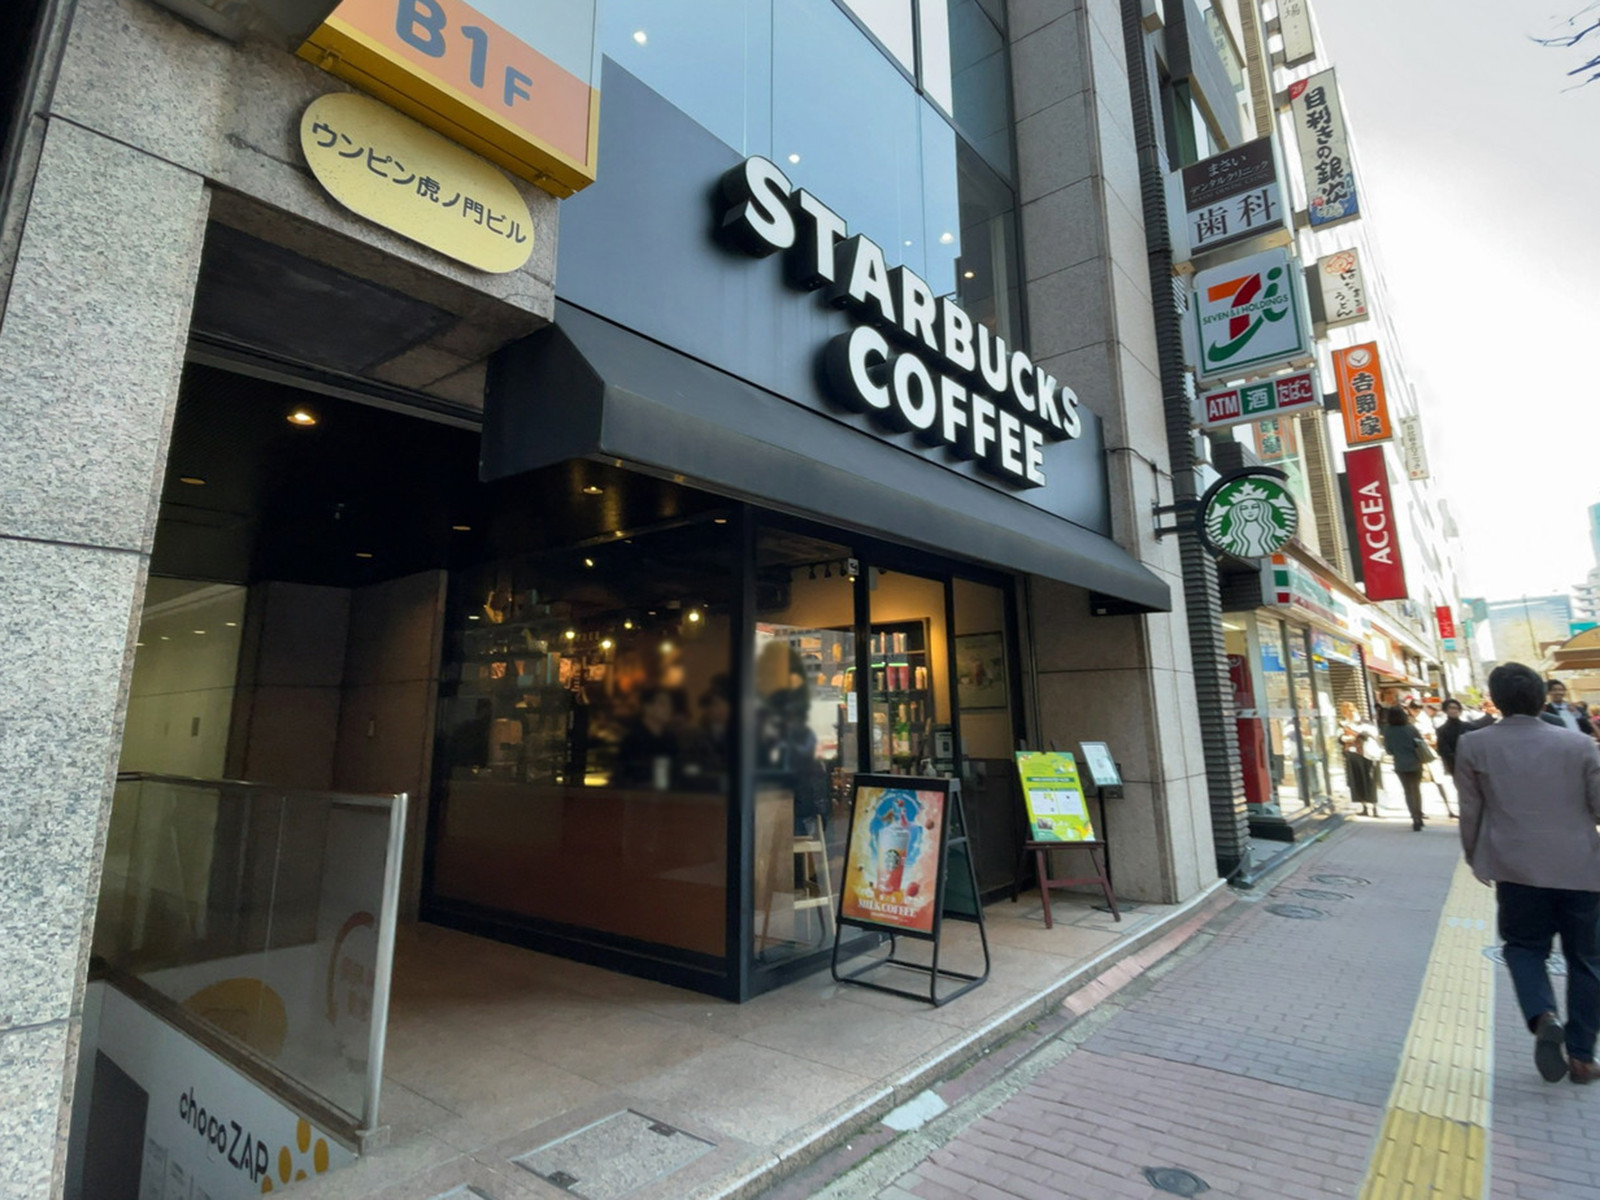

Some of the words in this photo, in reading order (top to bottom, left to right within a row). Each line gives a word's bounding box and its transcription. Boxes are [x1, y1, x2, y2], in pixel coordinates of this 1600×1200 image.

[312, 121, 527, 244] ウンピン虎ノ門ビル
[1208, 155, 1247, 177] まさい
[1303, 85, 1348, 206] 目利きの銀次
[1193, 188, 1277, 243] 歯科
[744, 154, 1082, 439] STARBUCKS
[1335, 291, 1353, 317] うどん
[848, 325, 1046, 487] COFFEE
[1208, 394, 1240, 418] ATM
[1246, 387, 1269, 411] 酒
[1277, 379, 1313, 403] たばこ
[1357, 479, 1394, 566] ACCEA
[179, 1086, 269, 1184] chocoZAP
